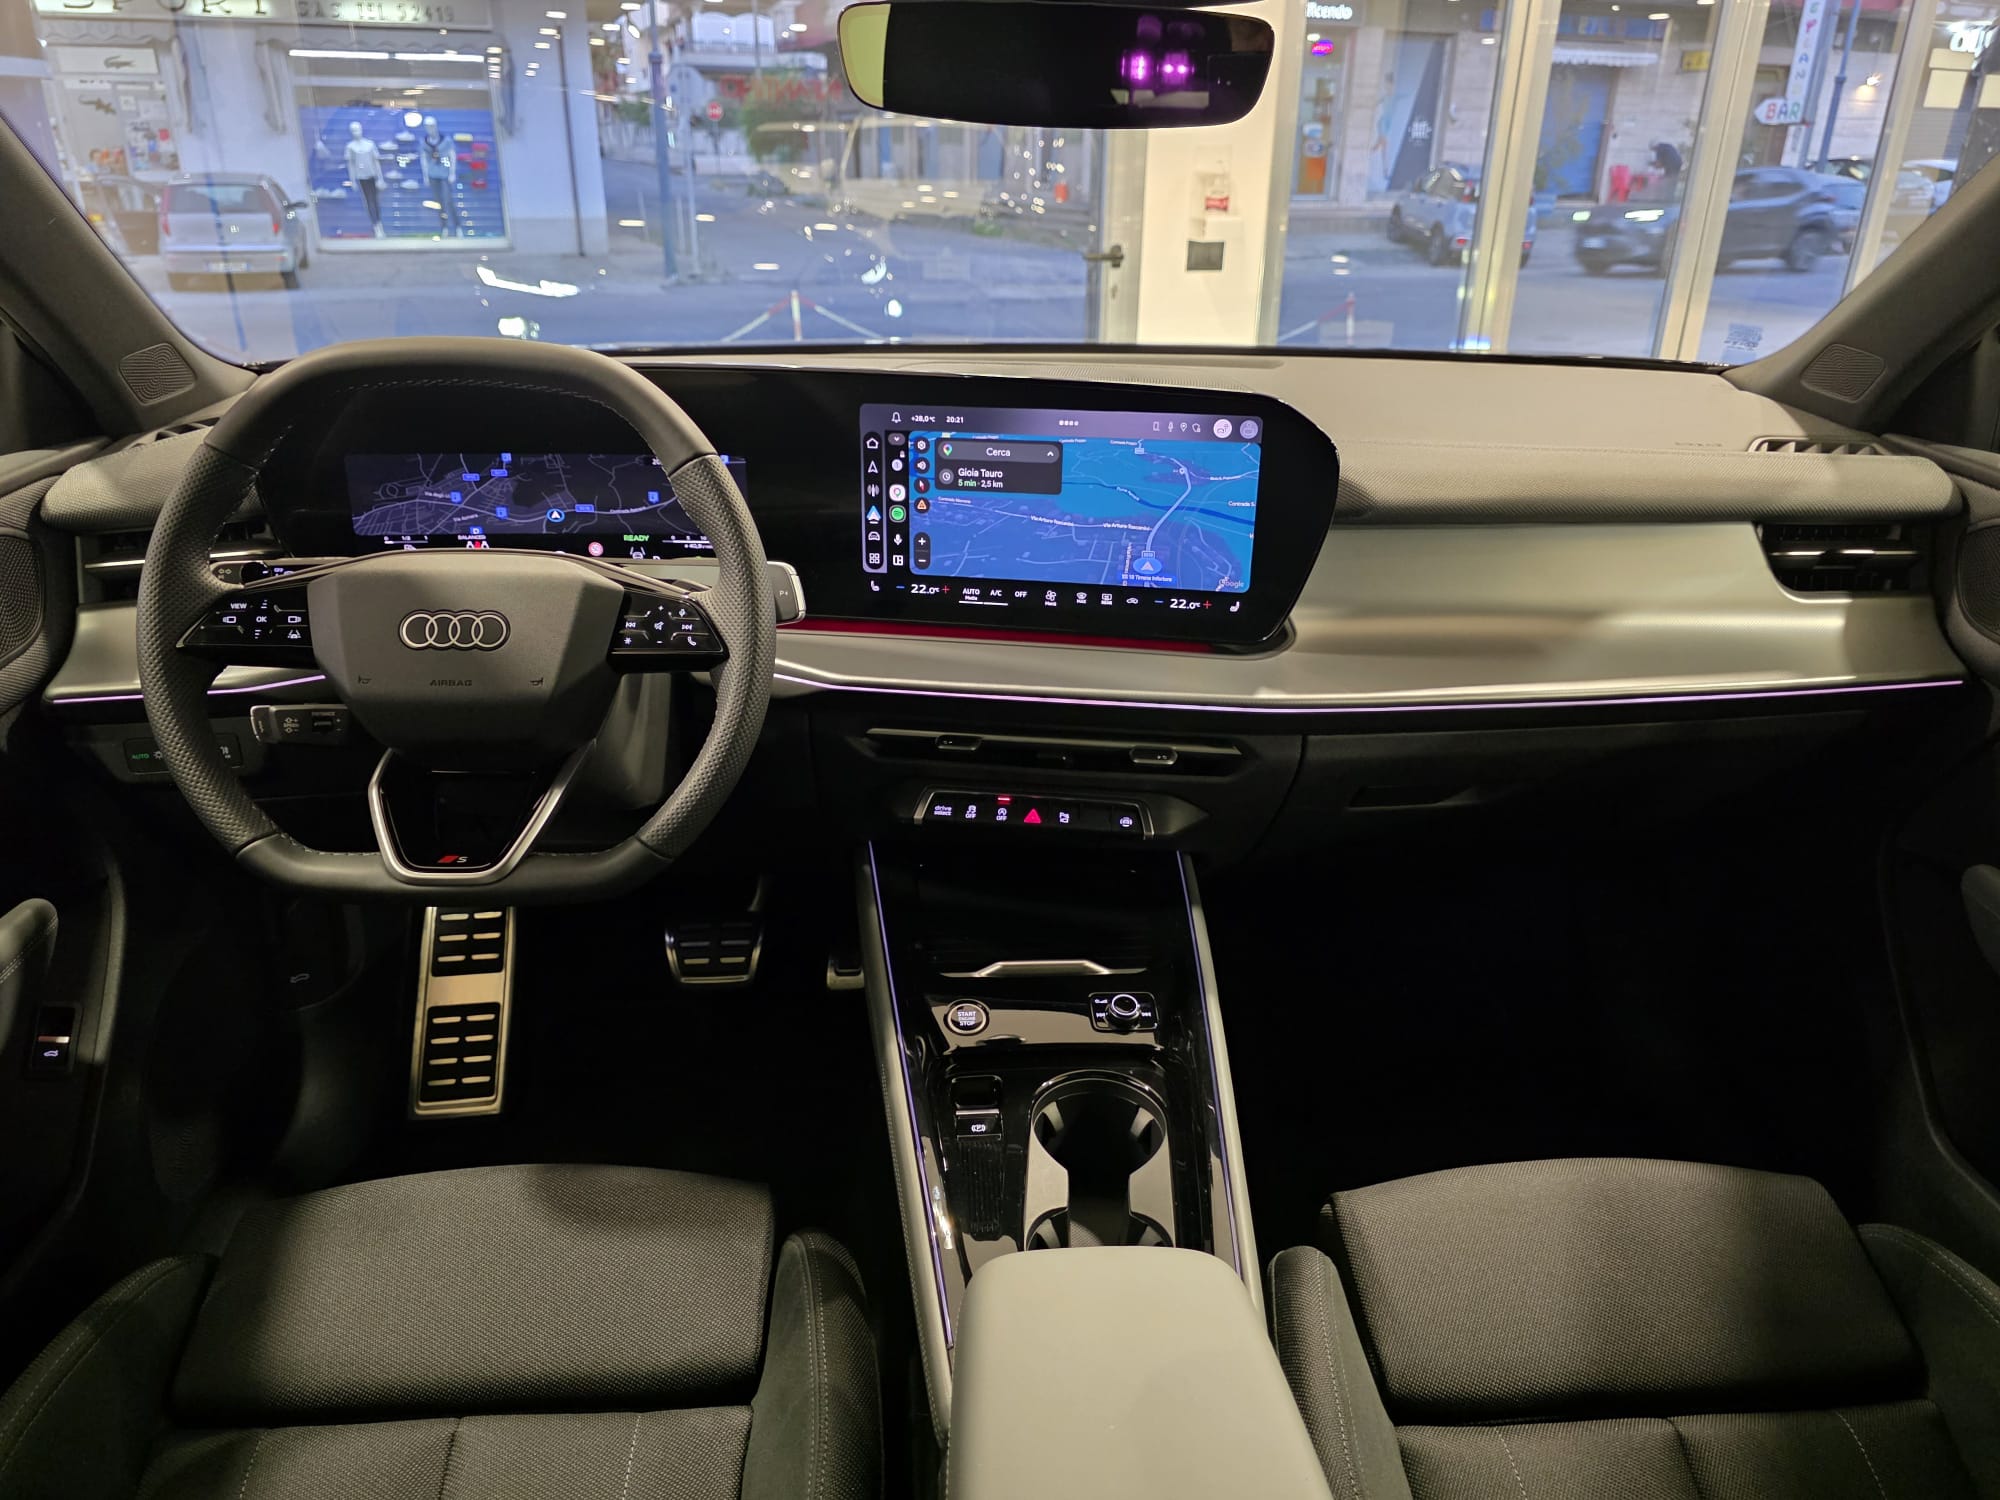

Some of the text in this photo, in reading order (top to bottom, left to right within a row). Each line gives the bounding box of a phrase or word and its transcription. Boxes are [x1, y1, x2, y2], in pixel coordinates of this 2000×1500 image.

[1765, 102, 1800, 121] BAR
[946, 416, 964, 424] 20:21
[986, 447, 1011, 457] Cerca
[958, 467, 1003, 478] Gioia Tauro
[958, 479, 963, 487] 5
[981, 480, 991, 488] 2,5
[992, 481, 1003, 489] km
[990, 589, 1002, 597] A/C
[429, 679, 473, 687] AIRBAG
